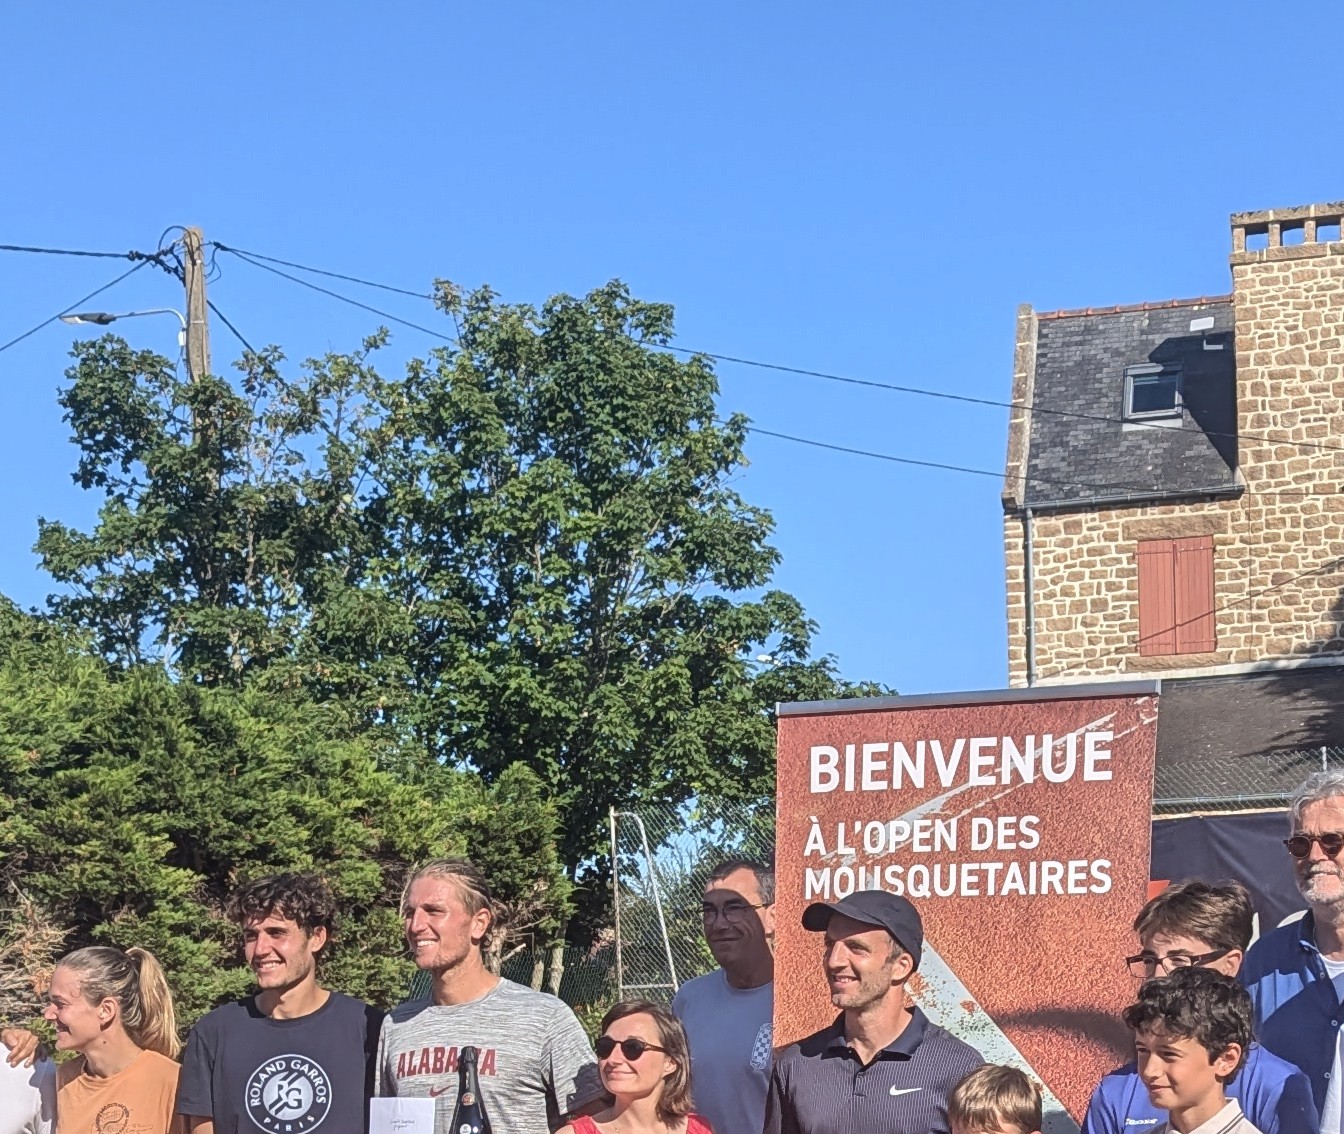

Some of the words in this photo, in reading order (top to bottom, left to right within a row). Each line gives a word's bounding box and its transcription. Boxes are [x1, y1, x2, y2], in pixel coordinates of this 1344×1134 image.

[810, 731, 1114, 793] BIENVENUE
[803, 816, 827, 856] À
[837, 818, 957, 855] L'OPEN
[971, 815, 1040, 851] DES
[805, 859, 1112, 900] MOUSQUETAIRES
[250, 1060, 286, 1107] ROLAND
[290, 1059, 327, 1104] GARROS
[396, 1046, 496, 1080] ALABAA
[263, 1115, 315, 1132] PARIS
